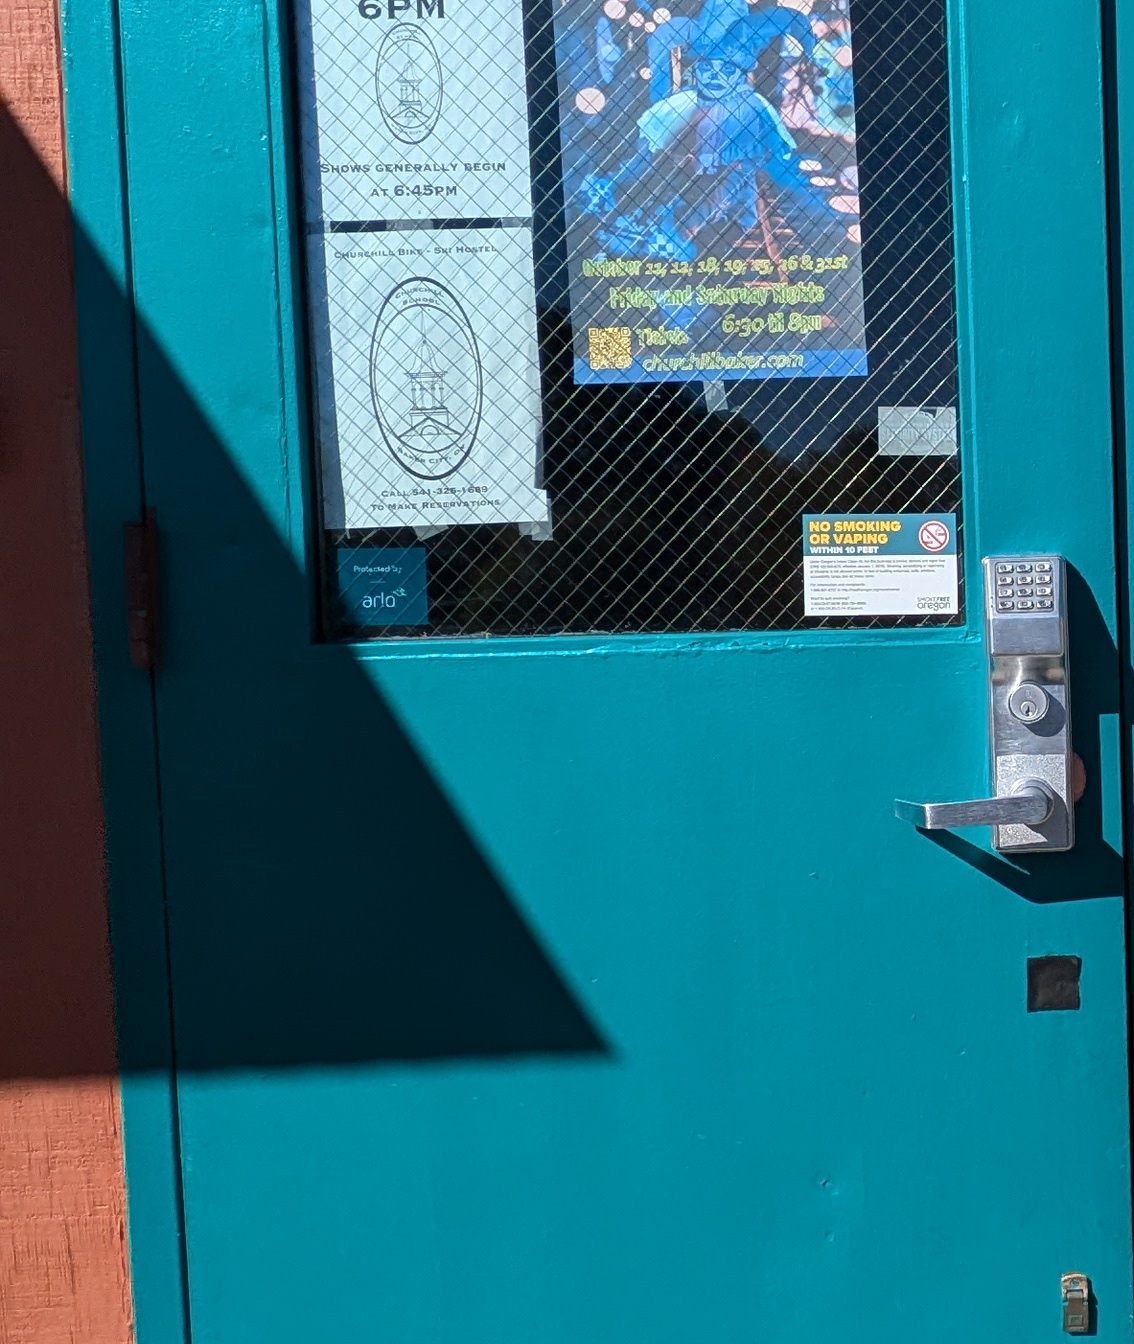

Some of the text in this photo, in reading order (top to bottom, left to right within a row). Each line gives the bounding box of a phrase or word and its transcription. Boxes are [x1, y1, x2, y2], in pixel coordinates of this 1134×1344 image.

[319, 162, 506, 173] SHOWS GENERALLY BEGIN
[370, 185, 457, 197] AT 6:45PM
[334, 250, 396, 259] CHURCHILL
[398, 248, 422, 256] BIKE
[456, 245, 498, 254] HOSTEL
[609, 287, 660, 309] Friday
[663, 285, 692, 306] and
[722, 313, 765, 337] 6:30
[381, 490, 410, 498] CALL
[371, 499, 501, 511] TO MAKE RESERVATIONS
[808, 520, 902, 532] NO SMOKING
[808, 533, 890, 545] OR VAPING
[809, 546, 880, 554] WITHIN 10 FEET
[362, 591, 396, 609] arlo
[917, 601, 951, 612] oregon
